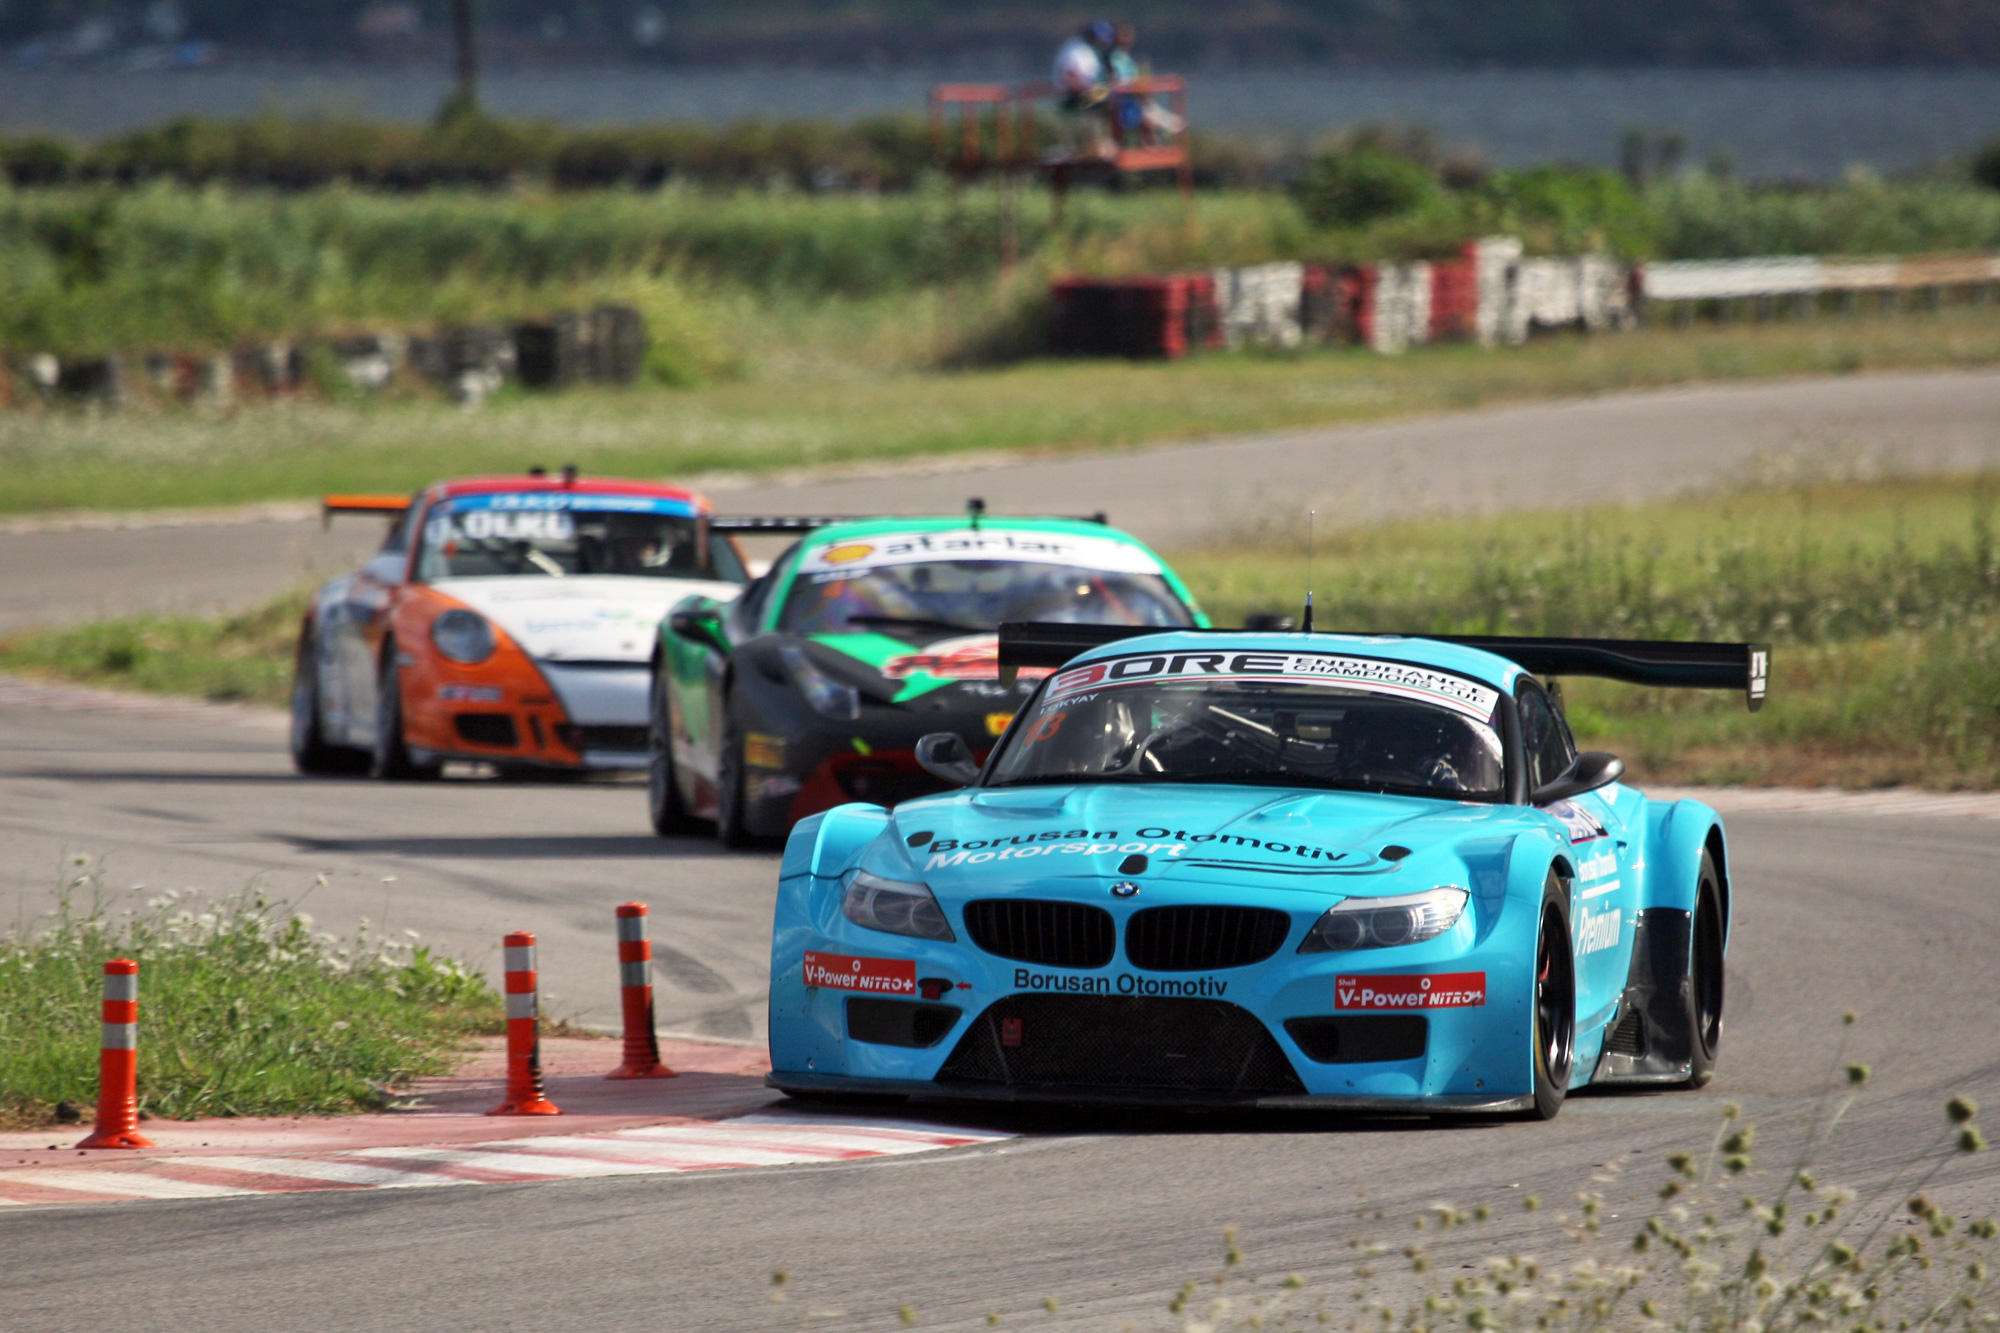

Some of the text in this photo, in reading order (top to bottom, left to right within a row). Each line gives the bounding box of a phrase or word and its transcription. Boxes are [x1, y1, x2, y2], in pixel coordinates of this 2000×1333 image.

[1293, 665, 1485, 704] CHAMPIONS CUP
[1295, 657, 1488, 699] ENDURANCE
[1022, 712, 1068, 746] 13
[923, 841, 1188, 873] Motorsport
[928, 827, 1350, 861] Borusan Otomotiv
[1576, 900, 1621, 958] Premium
[805, 964, 857, 988] V-Power
[1014, 968, 1228, 997] Borusan Otomotiv
[1338, 978, 1357, 987] Shell
[1338, 988, 1427, 1007] V-Power
